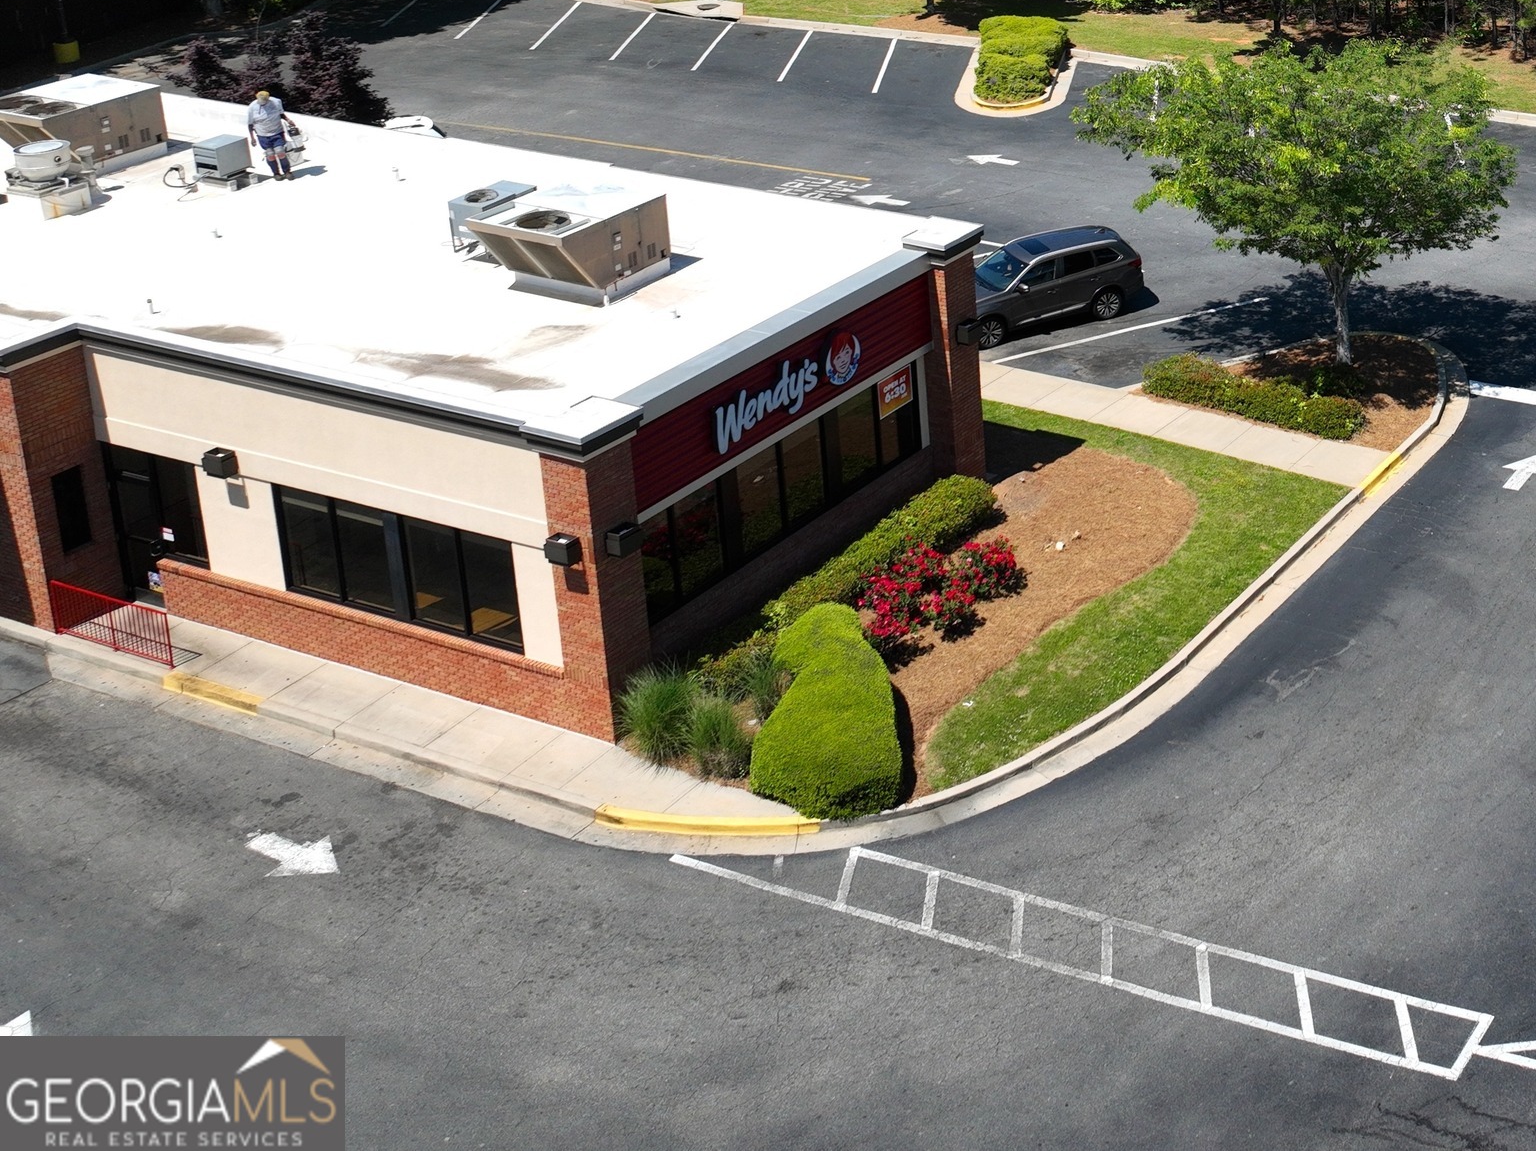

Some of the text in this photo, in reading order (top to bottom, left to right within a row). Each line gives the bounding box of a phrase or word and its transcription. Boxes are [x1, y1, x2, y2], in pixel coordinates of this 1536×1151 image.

[766, 176, 833, 196] HRU
[800, 180, 872, 202] RIVE
[883, 374, 907, 393] OPEN AT
[884, 383, 907, 404] 6:30
[715, 358, 819, 455] Wendy's
